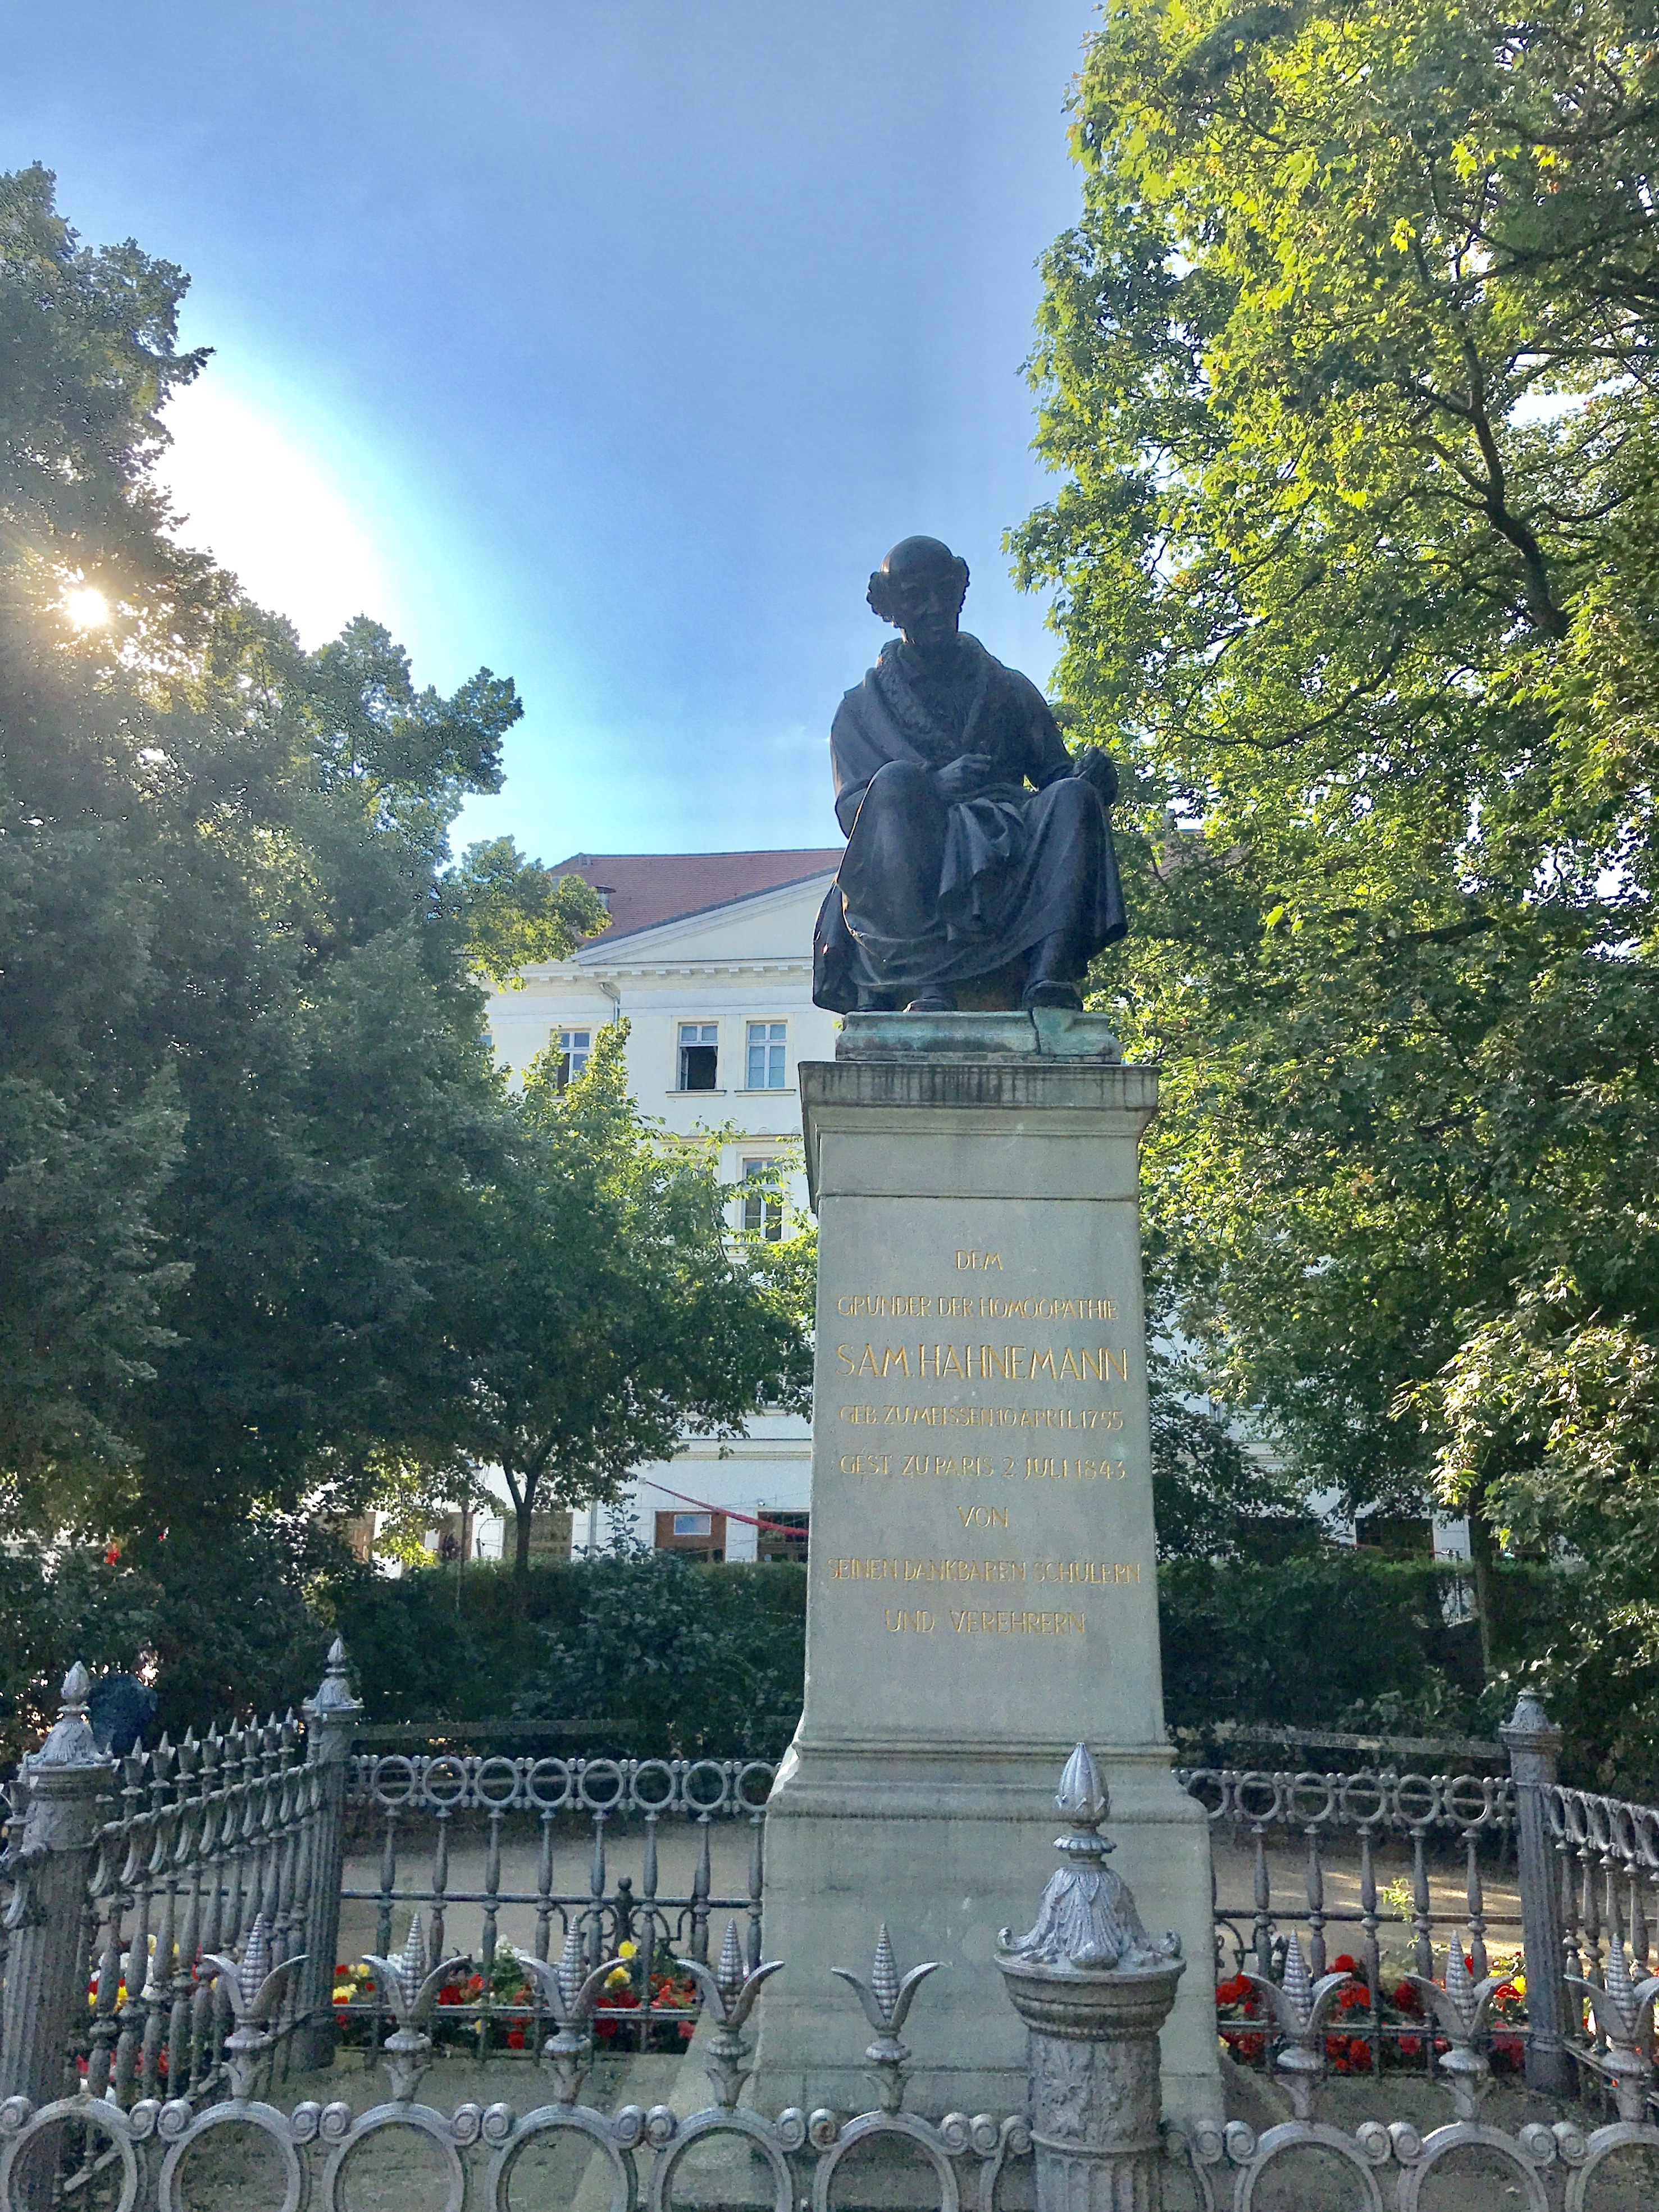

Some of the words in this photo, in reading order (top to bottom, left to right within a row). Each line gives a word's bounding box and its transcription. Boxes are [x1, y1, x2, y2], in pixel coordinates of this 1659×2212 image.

[956, 1249, 1003, 1271] DEM
[938, 1296, 973, 1317] DER
[919, 1343, 1128, 1381] HAHNEMANN
[883, 1405, 909, 1425] ZU
[911, 1406, 993, 1426] MEISSEN
[1020, 1408, 1078, 1429] APRIL
[1079, 1410, 1123, 1430] 1755
[902, 1454, 929, 1475] ZU
[935, 1456, 993, 1477] PARIS
[1023, 1457, 1067, 1481] JULI
[1074, 1458, 1125, 1480] 1843
[956, 1506, 1008, 1528] VON
[827, 1558, 897, 1580] SEINEN
[904, 1558, 1026, 1582] DANKBAREN
[885, 1609, 935, 1633] UND
[950, 1610, 1085, 1634] VEREHRERN
